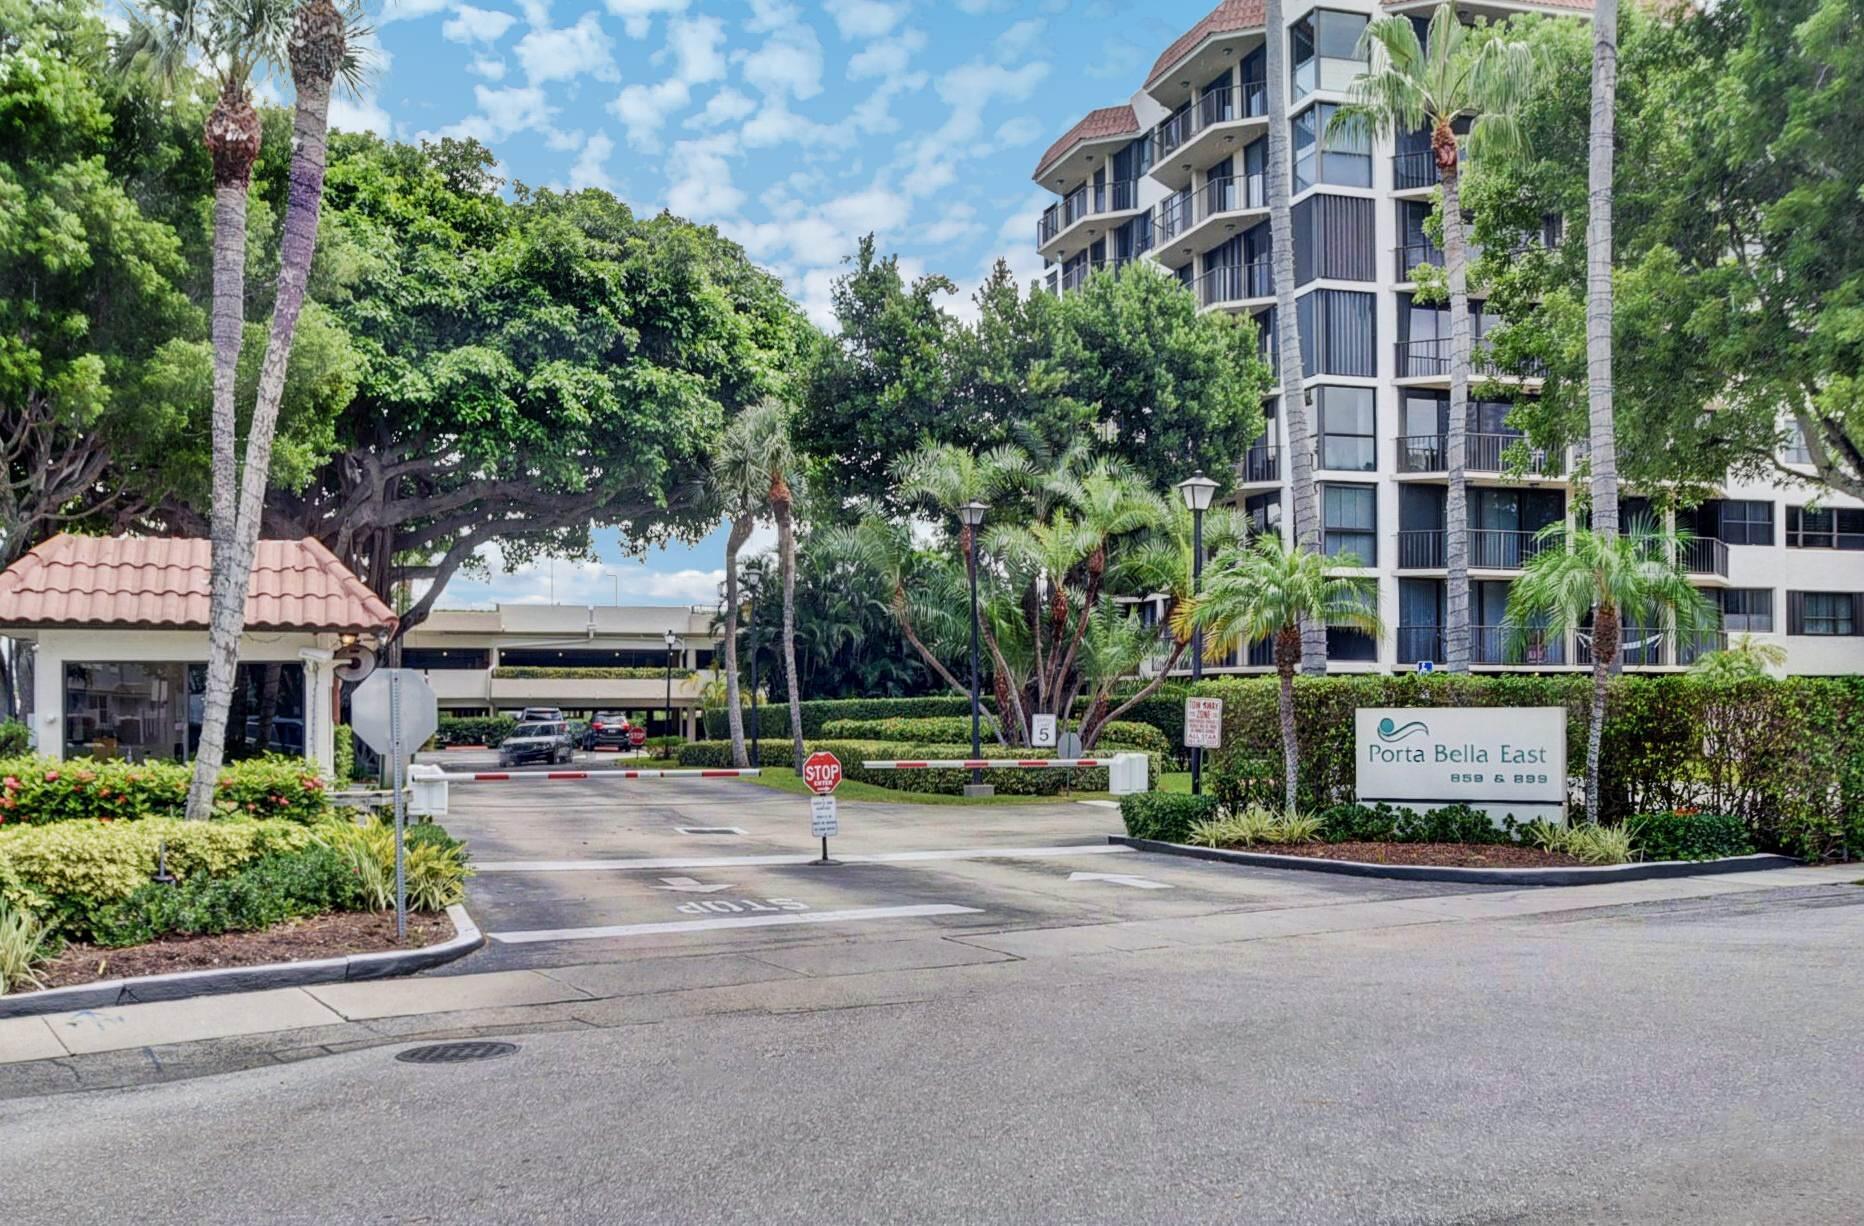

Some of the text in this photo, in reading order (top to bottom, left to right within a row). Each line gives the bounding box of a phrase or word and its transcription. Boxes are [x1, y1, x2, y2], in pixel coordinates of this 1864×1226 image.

[1039, 728, 1049, 741] 5
[1369, 744, 1547, 764] Porta Bella East
[805, 764, 839, 781] STOP
[1450, 773, 1548, 784] 859 & 899
[676, 898, 810, 914] STOP
